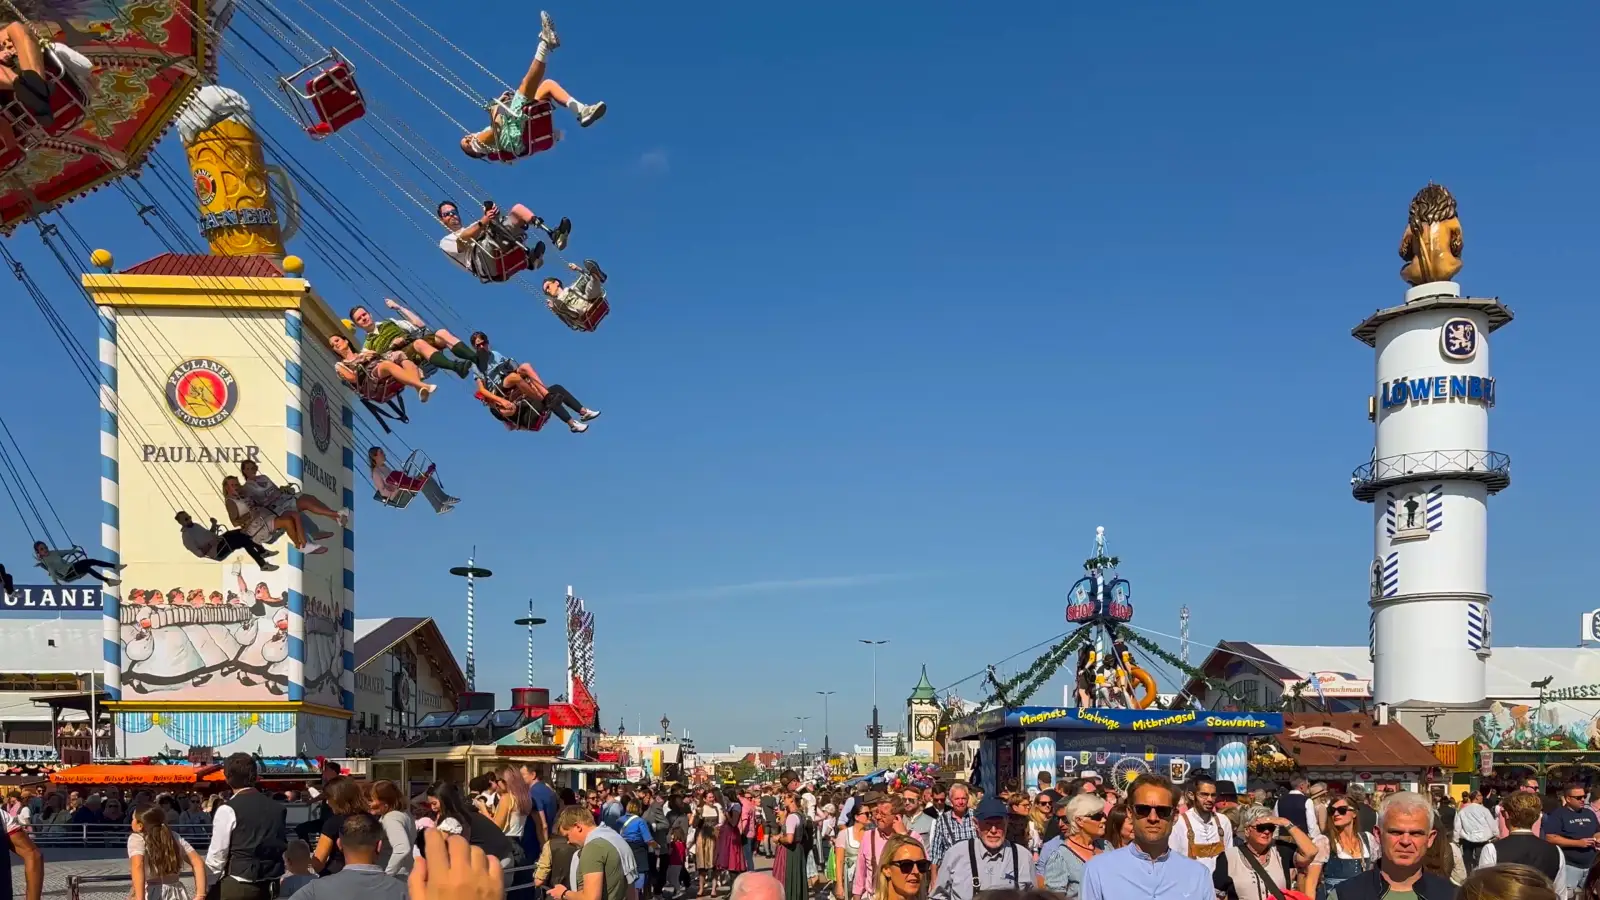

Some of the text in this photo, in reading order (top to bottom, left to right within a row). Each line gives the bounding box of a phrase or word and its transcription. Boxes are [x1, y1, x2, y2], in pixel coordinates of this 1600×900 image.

[168, 360, 234, 385] PAULANER
[1382, 375, 1496, 409] LÖWENBR
[174, 408, 230, 427] MÜNCHEN
[142, 444, 262, 463] PAULANER
[303, 455, 338, 495] PAULANER
[1068, 601, 1096, 620] SHOP
[1109, 602, 1132, 619] SHOP
[1020, 709, 1067, 726] Magnete
[1078, 707, 1120, 730] Bierkrüge
[1133, 711, 1196, 730] Mitbringsel
[1206, 716, 1266, 728] Souvenirs
